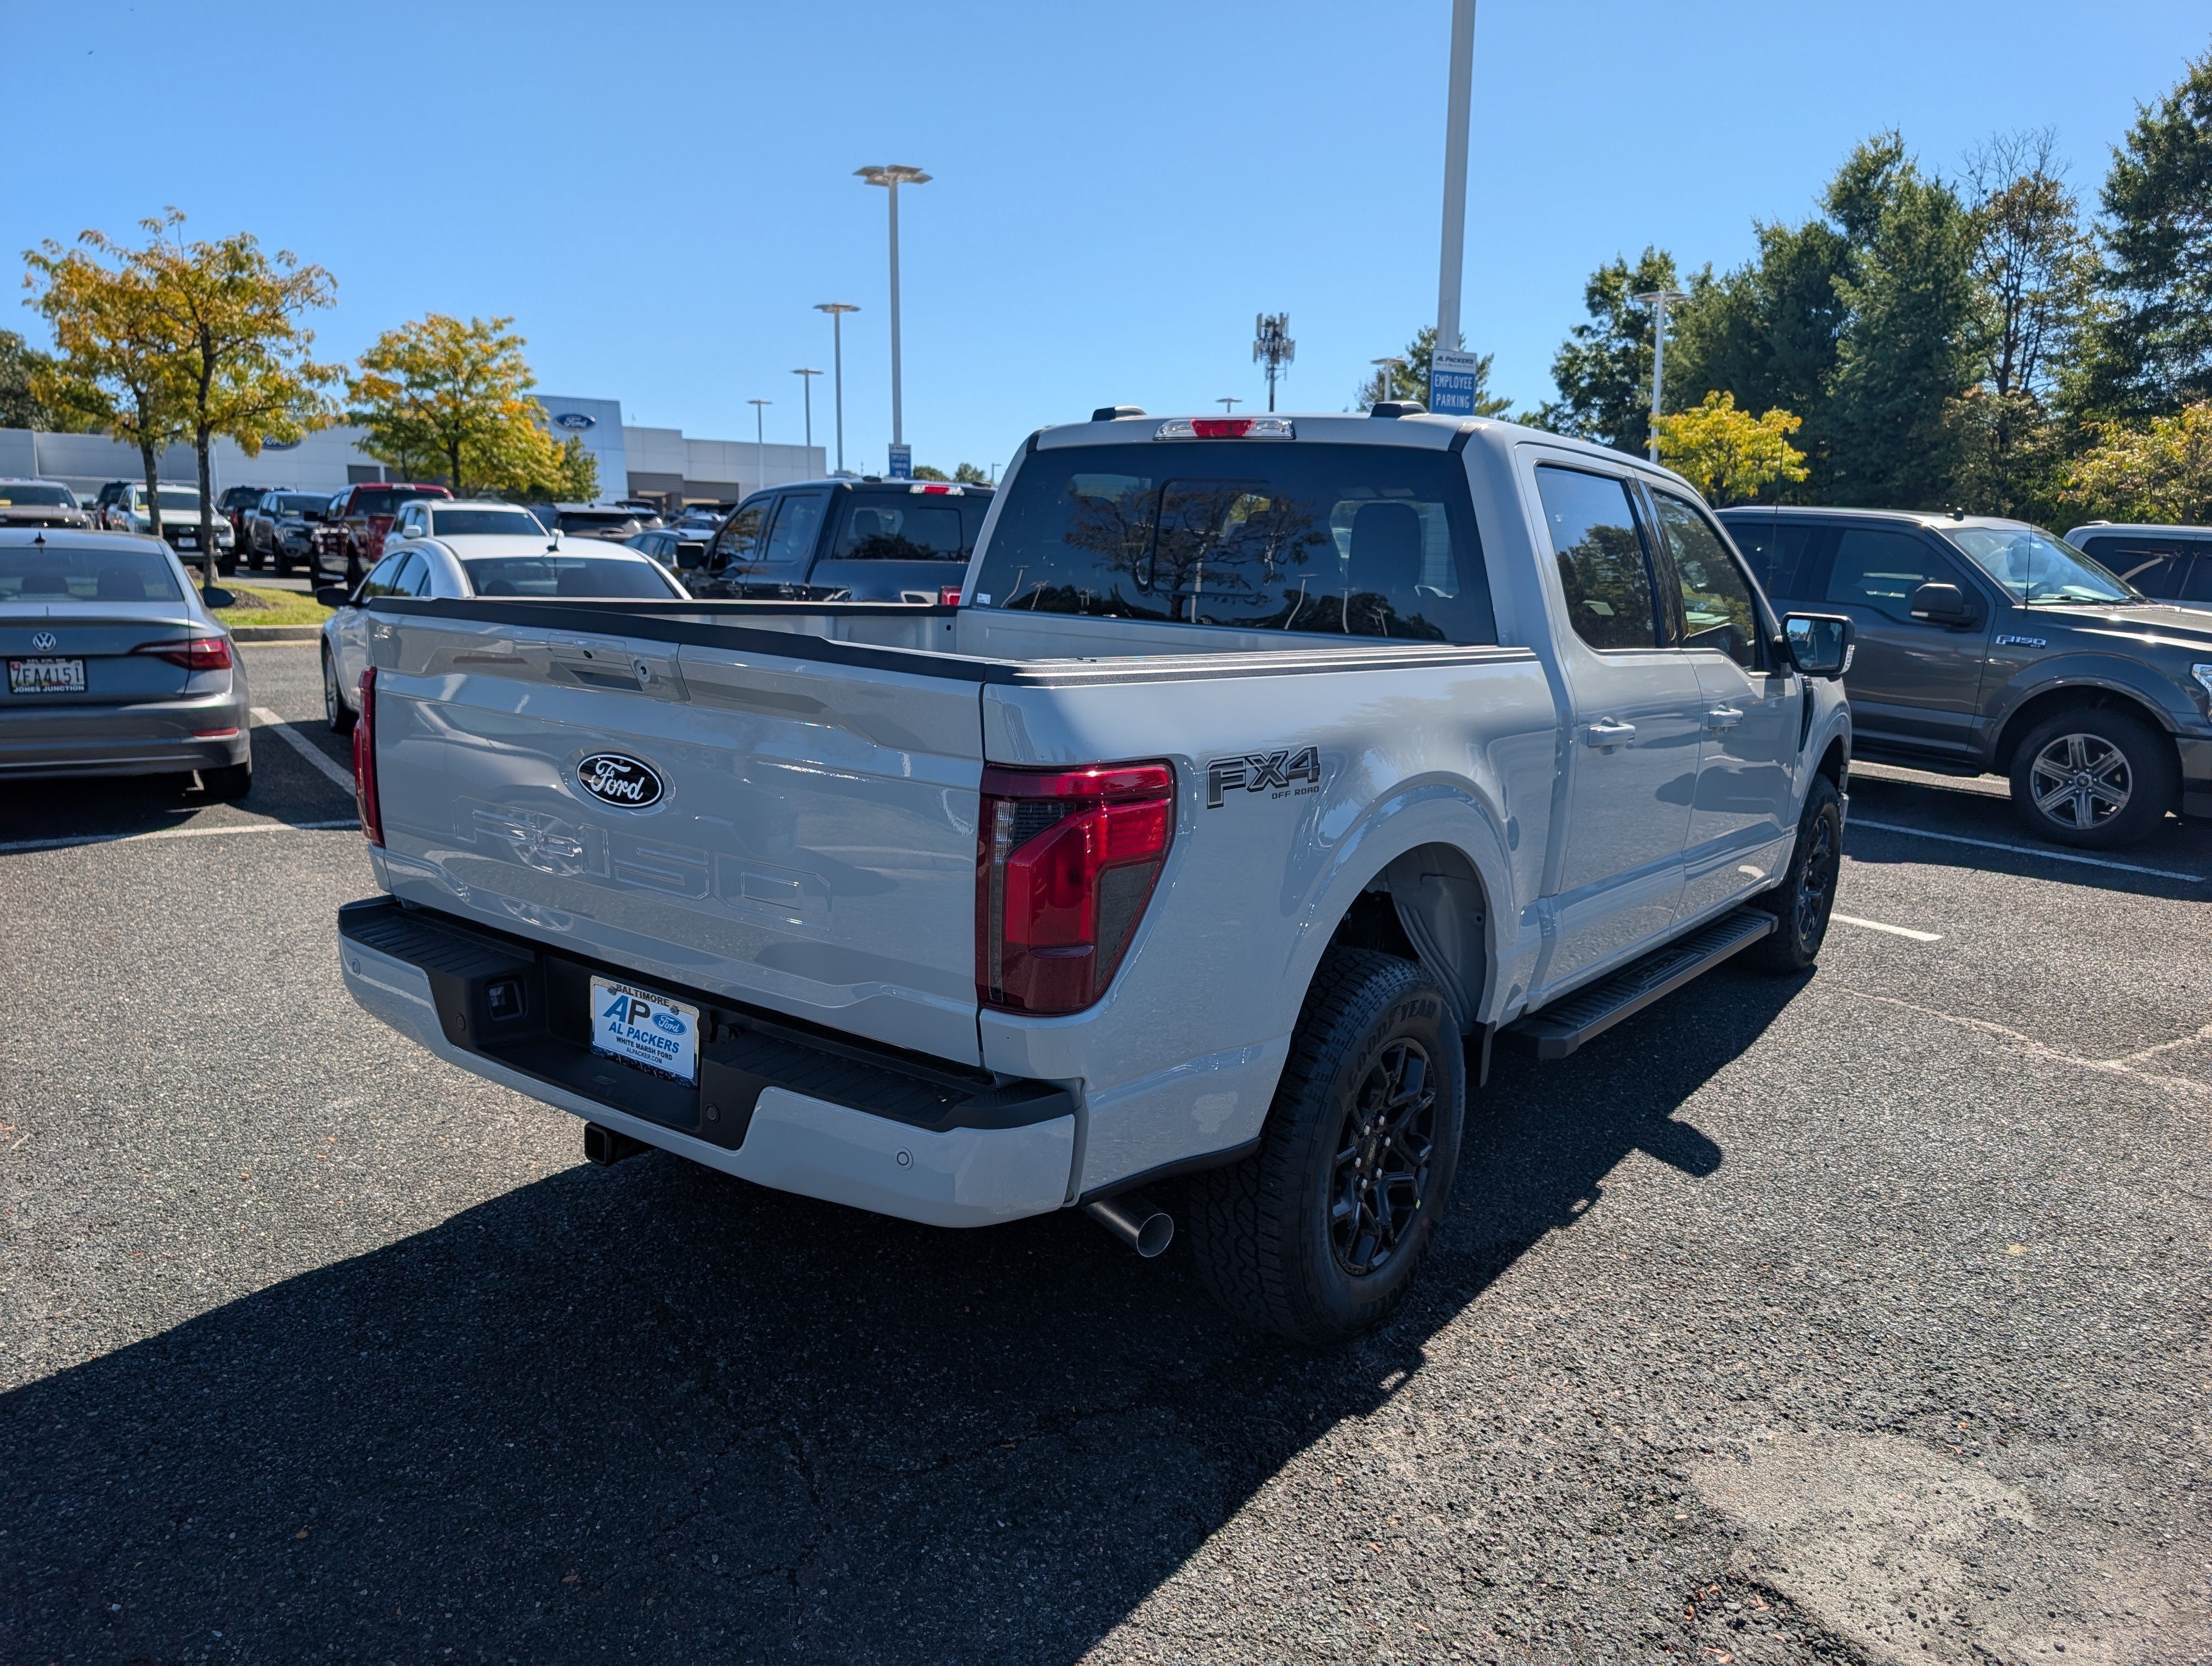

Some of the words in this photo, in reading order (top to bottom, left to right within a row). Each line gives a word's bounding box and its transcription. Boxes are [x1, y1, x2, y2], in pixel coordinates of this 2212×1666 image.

[1434, 374, 1473, 390] EMPLOYEE
[1435, 393, 1470, 408] PARKING
[564, 415, 588, 428] Ford
[589, 759, 645, 801] Ford
[1205, 745, 1321, 810] FX4
[1271, 790, 1291, 800] OFF
[1294, 786, 1320, 796] ROAD
[615, 984, 671, 1008] BALTIMORE
[602, 995, 651, 1026] AP
[658, 1015, 679, 1033] Ford
[608, 1021, 623, 1036] AL
[626, 1027, 680, 1054] PACKERS
[616, 1036, 634, 1047] WHITE
[635, 1043, 656, 1055] MARSH
[657, 1051, 673, 1061] FORD
[626, 1047, 663, 1064] ALPACKER.COM
